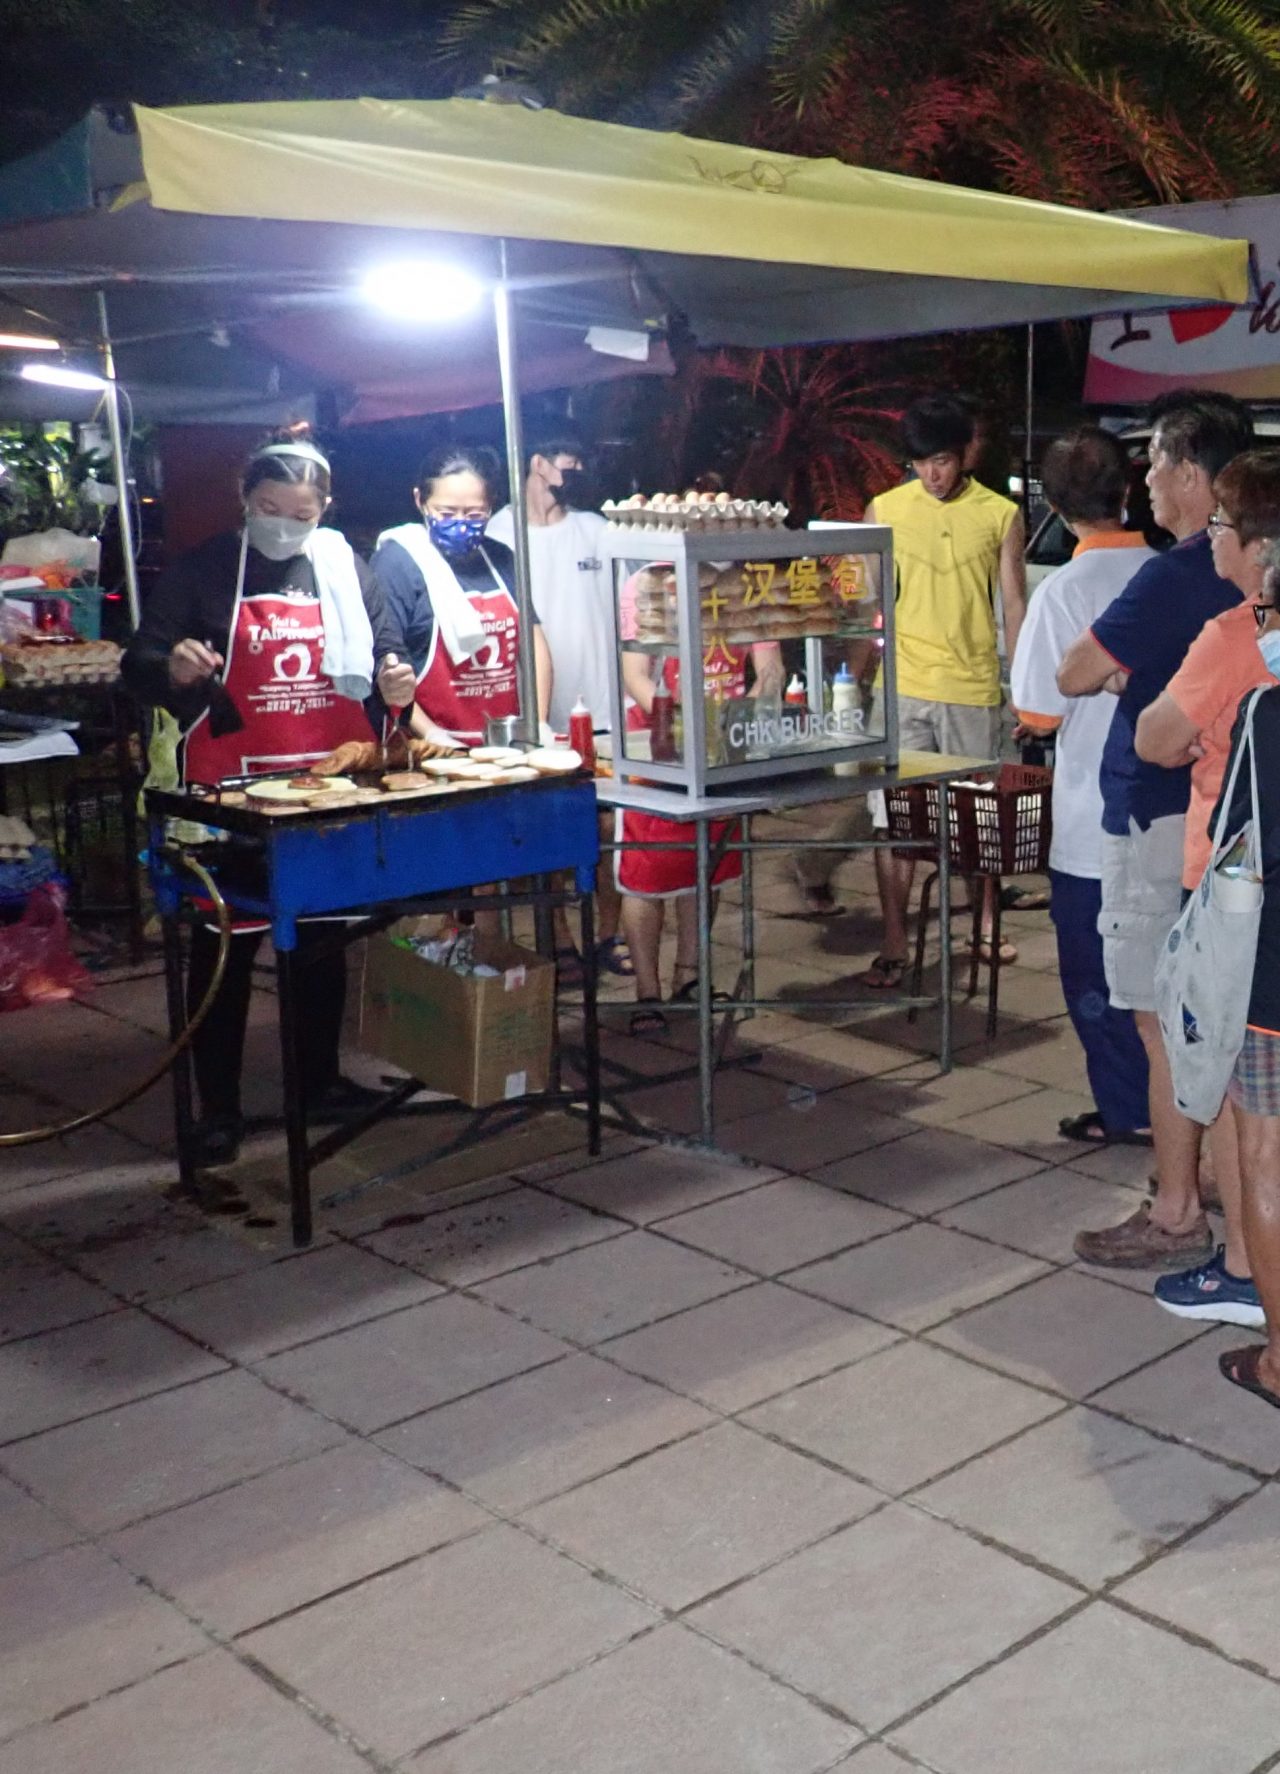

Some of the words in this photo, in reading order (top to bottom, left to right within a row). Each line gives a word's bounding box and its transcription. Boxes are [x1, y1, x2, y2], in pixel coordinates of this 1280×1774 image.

[740, 558, 870, 606] 汉堡包
[729, 721, 774, 748] CHK
[780, 708, 865, 742] BURGER
